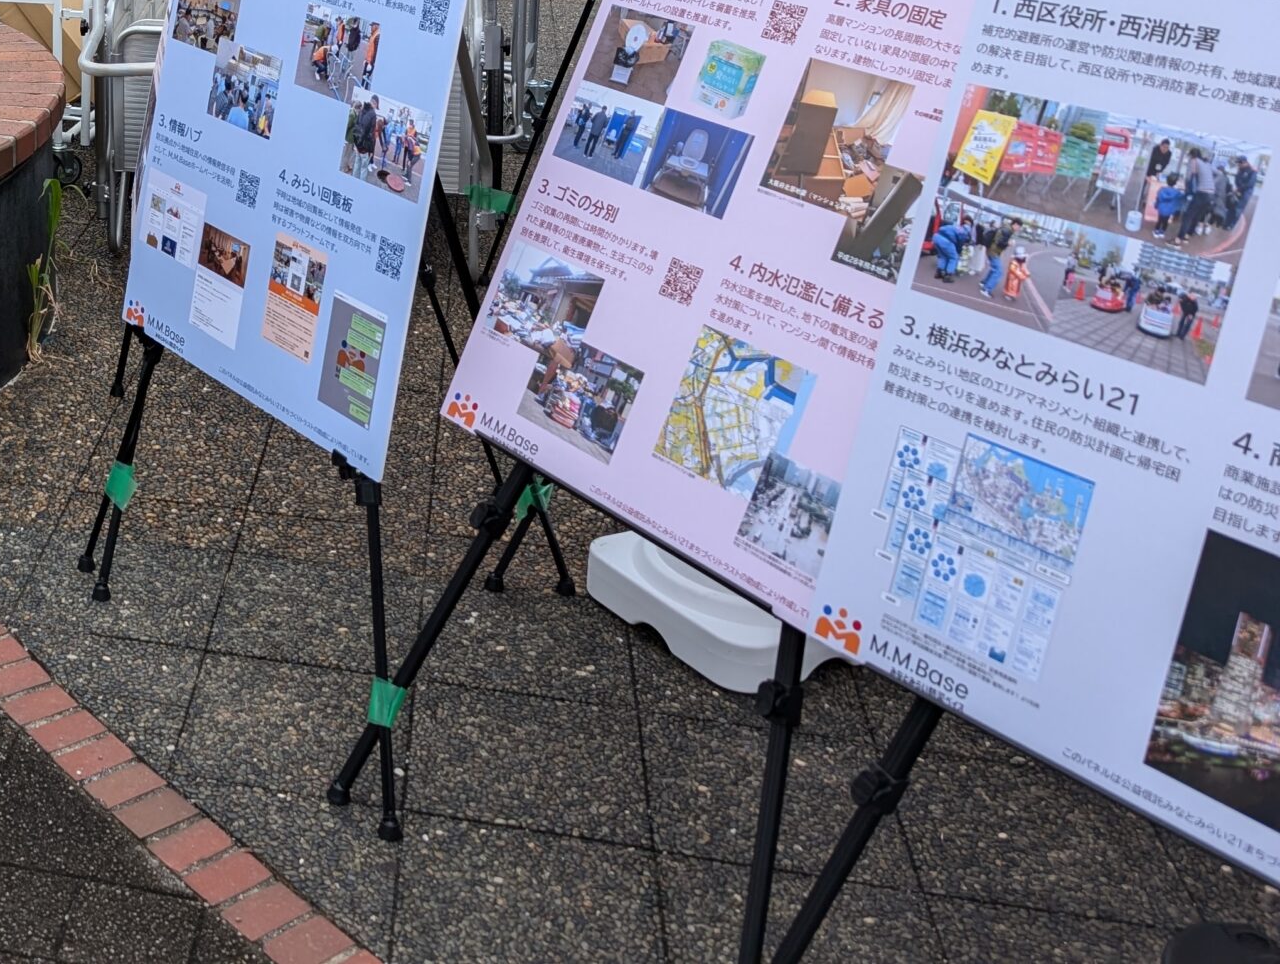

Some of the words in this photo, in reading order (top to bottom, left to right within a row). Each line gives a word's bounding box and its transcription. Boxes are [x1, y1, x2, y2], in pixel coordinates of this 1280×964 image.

[814, 44, 953, 88] なります。建物にしっかり固定しま
[970, 61, 1010, 80] めます。
[981, 23, 1280, 90] 補充的避難所の運営や防災関連情報の共有、地域課
[158, 114, 167, 129] 3.
[168, 117, 203, 143] 情報ハブ
[278, 169, 289, 185] 4.
[291, 173, 354, 214] みらい回覧板
[537, 178, 550, 196] 3.
[553, 185, 620, 224] ゴミの分別
[729, 254, 745, 275] 4.
[748, 261, 885, 330] 内水氾濫に備える
[147, 314, 185, 347] M.M.Base
[709, 308, 753, 336] を進めます。
[899, 315, 920, 340] 3.
[926, 323, 1140, 416] 横浜みなとみらい21
[883, 380, 1047, 454] 難者対策との連携を検討します。
[887, 362, 1182, 483] 防災まちづくりを進めます。住民の防災計画と帰宅困
[892, 344, 1191, 464] みなとみらい地区のエリアマネジメント組織と連携して、
[480, 412, 539, 456] M.M.Base
[1232, 432, 1260, 460] 4.
[869, 635, 969, 700] M.M.Base
